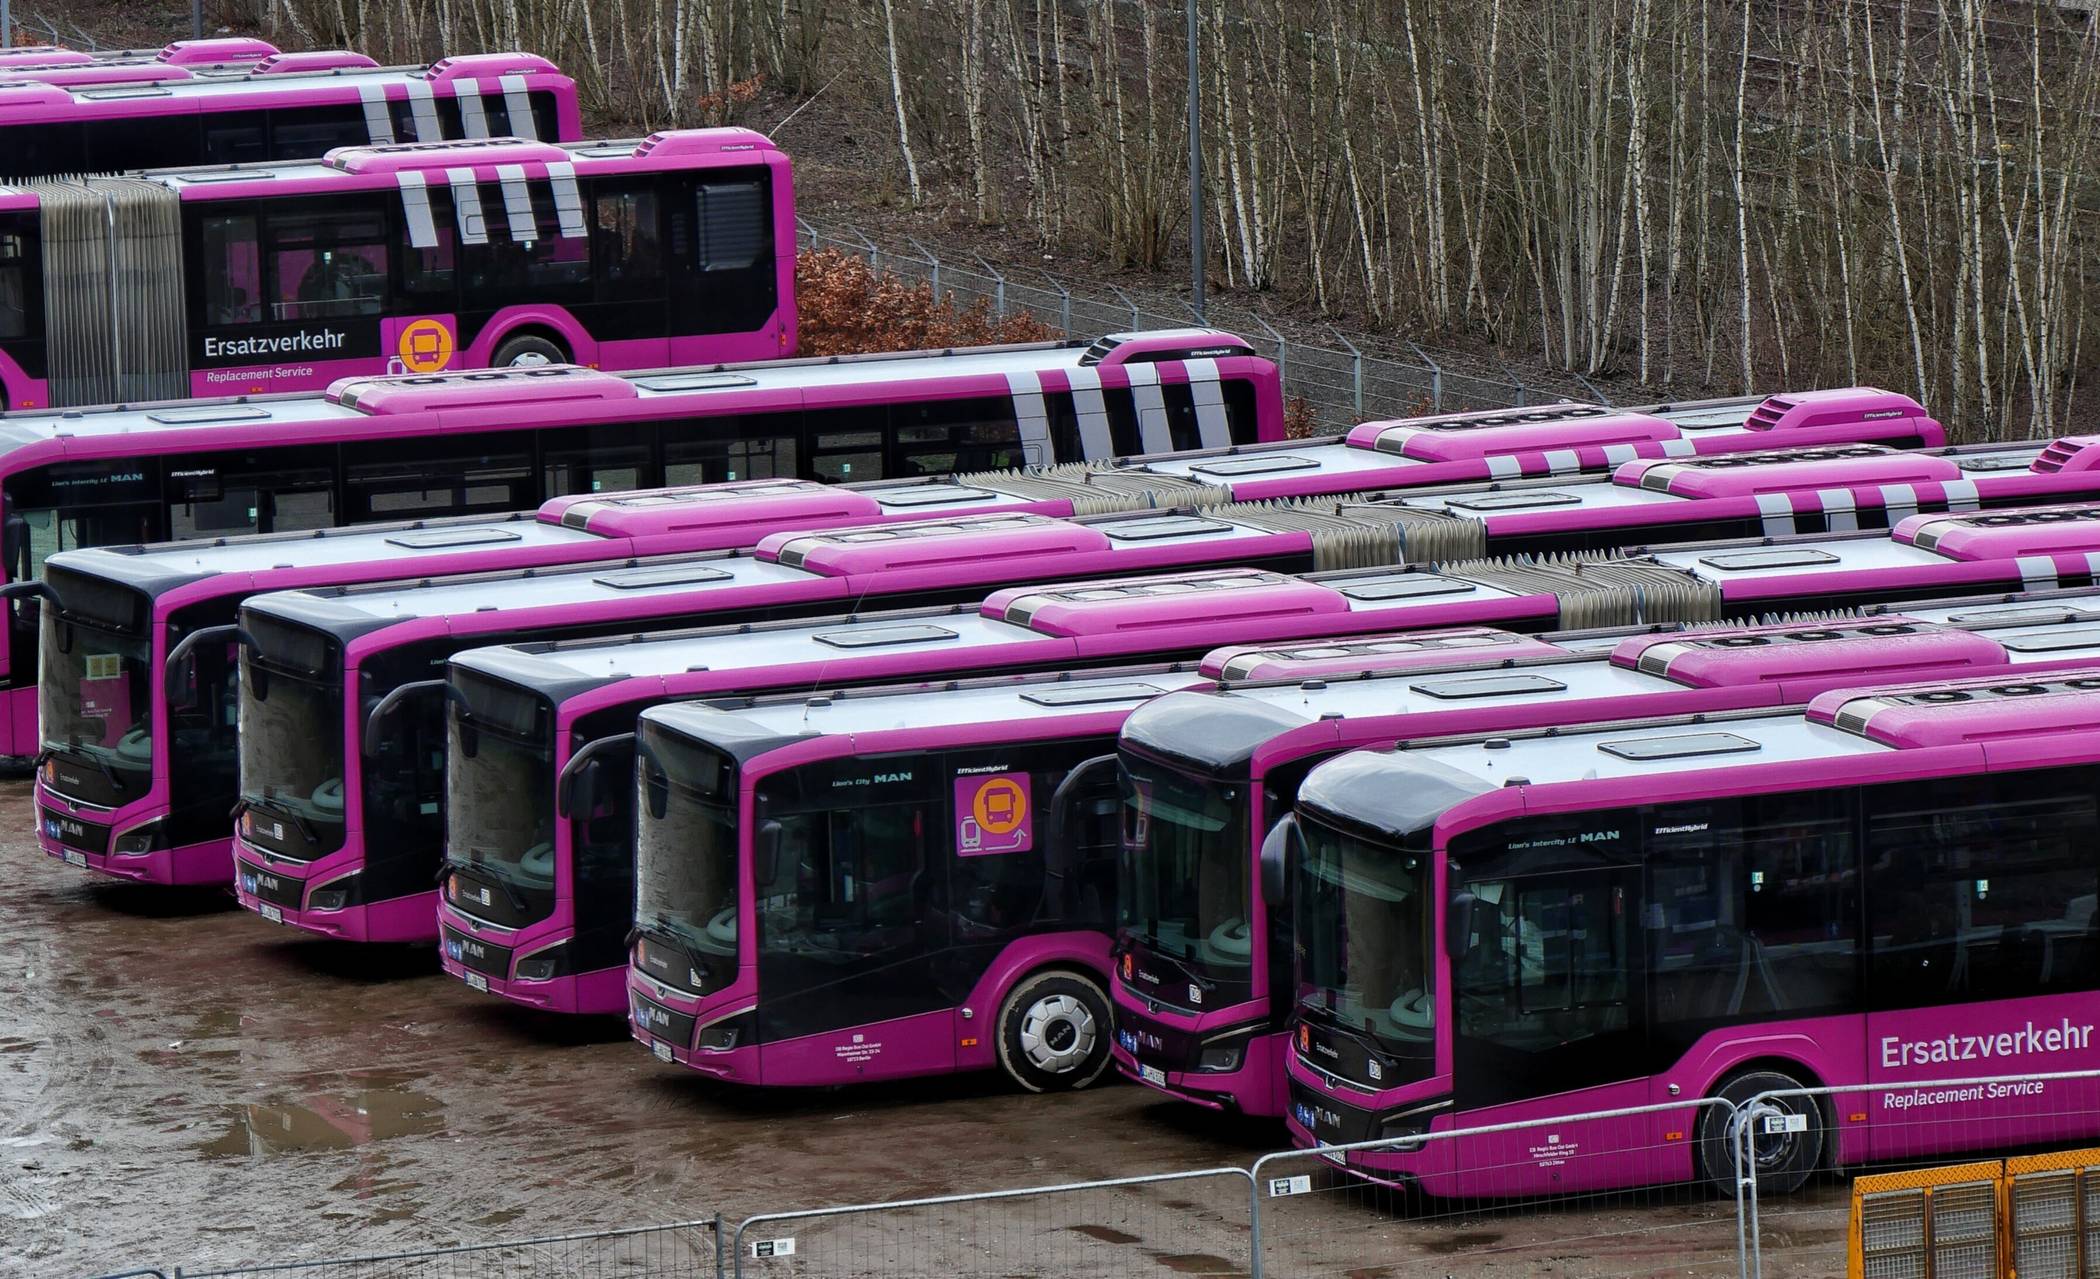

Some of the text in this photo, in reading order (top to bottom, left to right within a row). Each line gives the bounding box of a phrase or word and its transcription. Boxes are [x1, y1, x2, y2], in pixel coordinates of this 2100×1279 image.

[204, 328, 345, 357] Ersatzverkehr
[207, 366, 313, 383] Replacement Service
[111, 473, 143, 482] MAN
[874, 772, 912, 784] MAN
[957, 764, 1008, 774] EfficientHybrid
[60, 820, 84, 837] MAN
[1655, 823, 1708, 834] EfficientHybrid
[1508, 841, 1530, 849] Lion's
[1532, 838, 1565, 848] Intercity
[1580, 830, 1620, 843] MAN
[257, 873, 279, 891] MAN
[462, 940, 485, 959] MAN
[648, 1007, 670, 1027] MAN
[1138, 1030, 1163, 1051] MAN
[1881, 1018, 2095, 1068] Ersatzverkehr
[1883, 1080, 2044, 1110] Replacement Service
[1315, 1105, 1341, 1128] MAN
